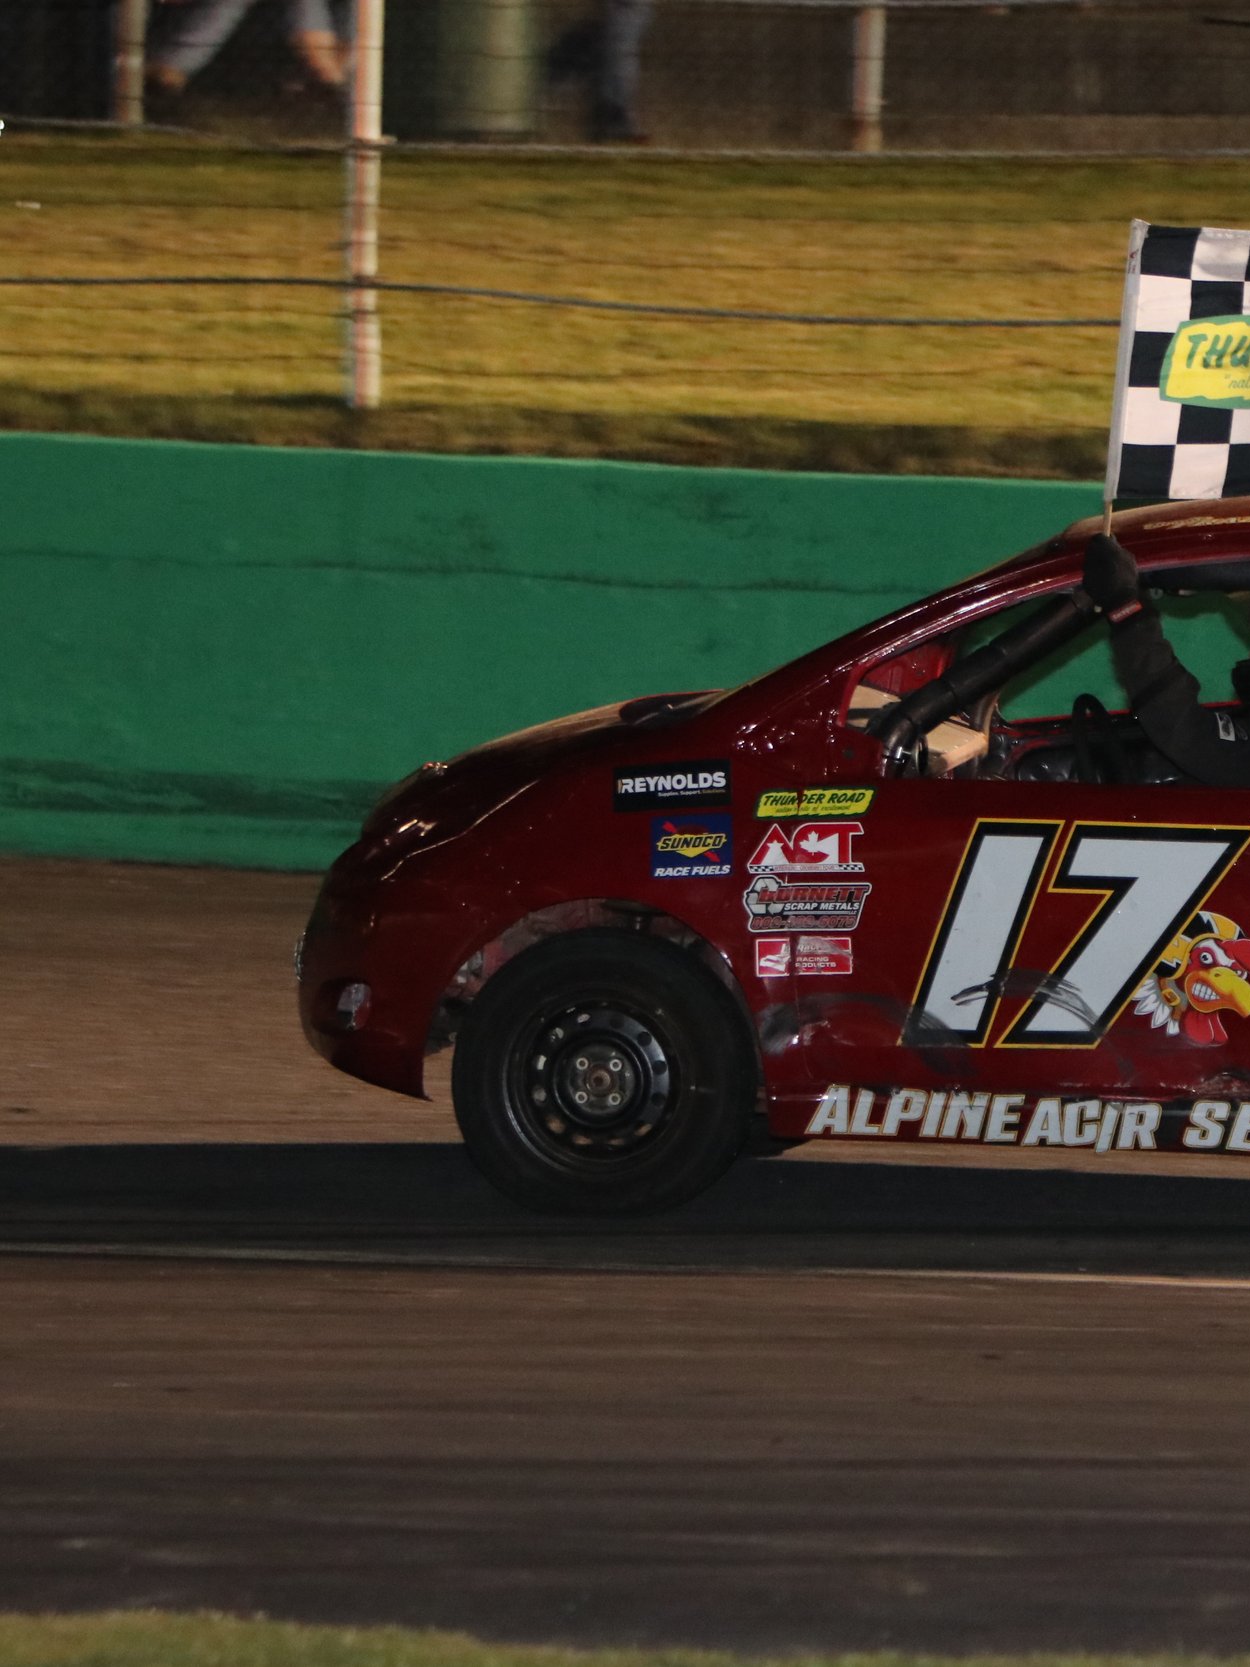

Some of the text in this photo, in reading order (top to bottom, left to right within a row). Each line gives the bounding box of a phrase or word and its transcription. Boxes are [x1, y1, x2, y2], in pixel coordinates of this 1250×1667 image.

[620, 772, 727, 794] REYNOLDS
[827, 792, 866, 804] ROAD
[660, 835, 723, 850] SUNOCO
[654, 865, 731, 877] RACE FUELS
[784, 902, 860, 911] SCRAP METALS
[804, 1084, 1025, 1142] ALPINE
